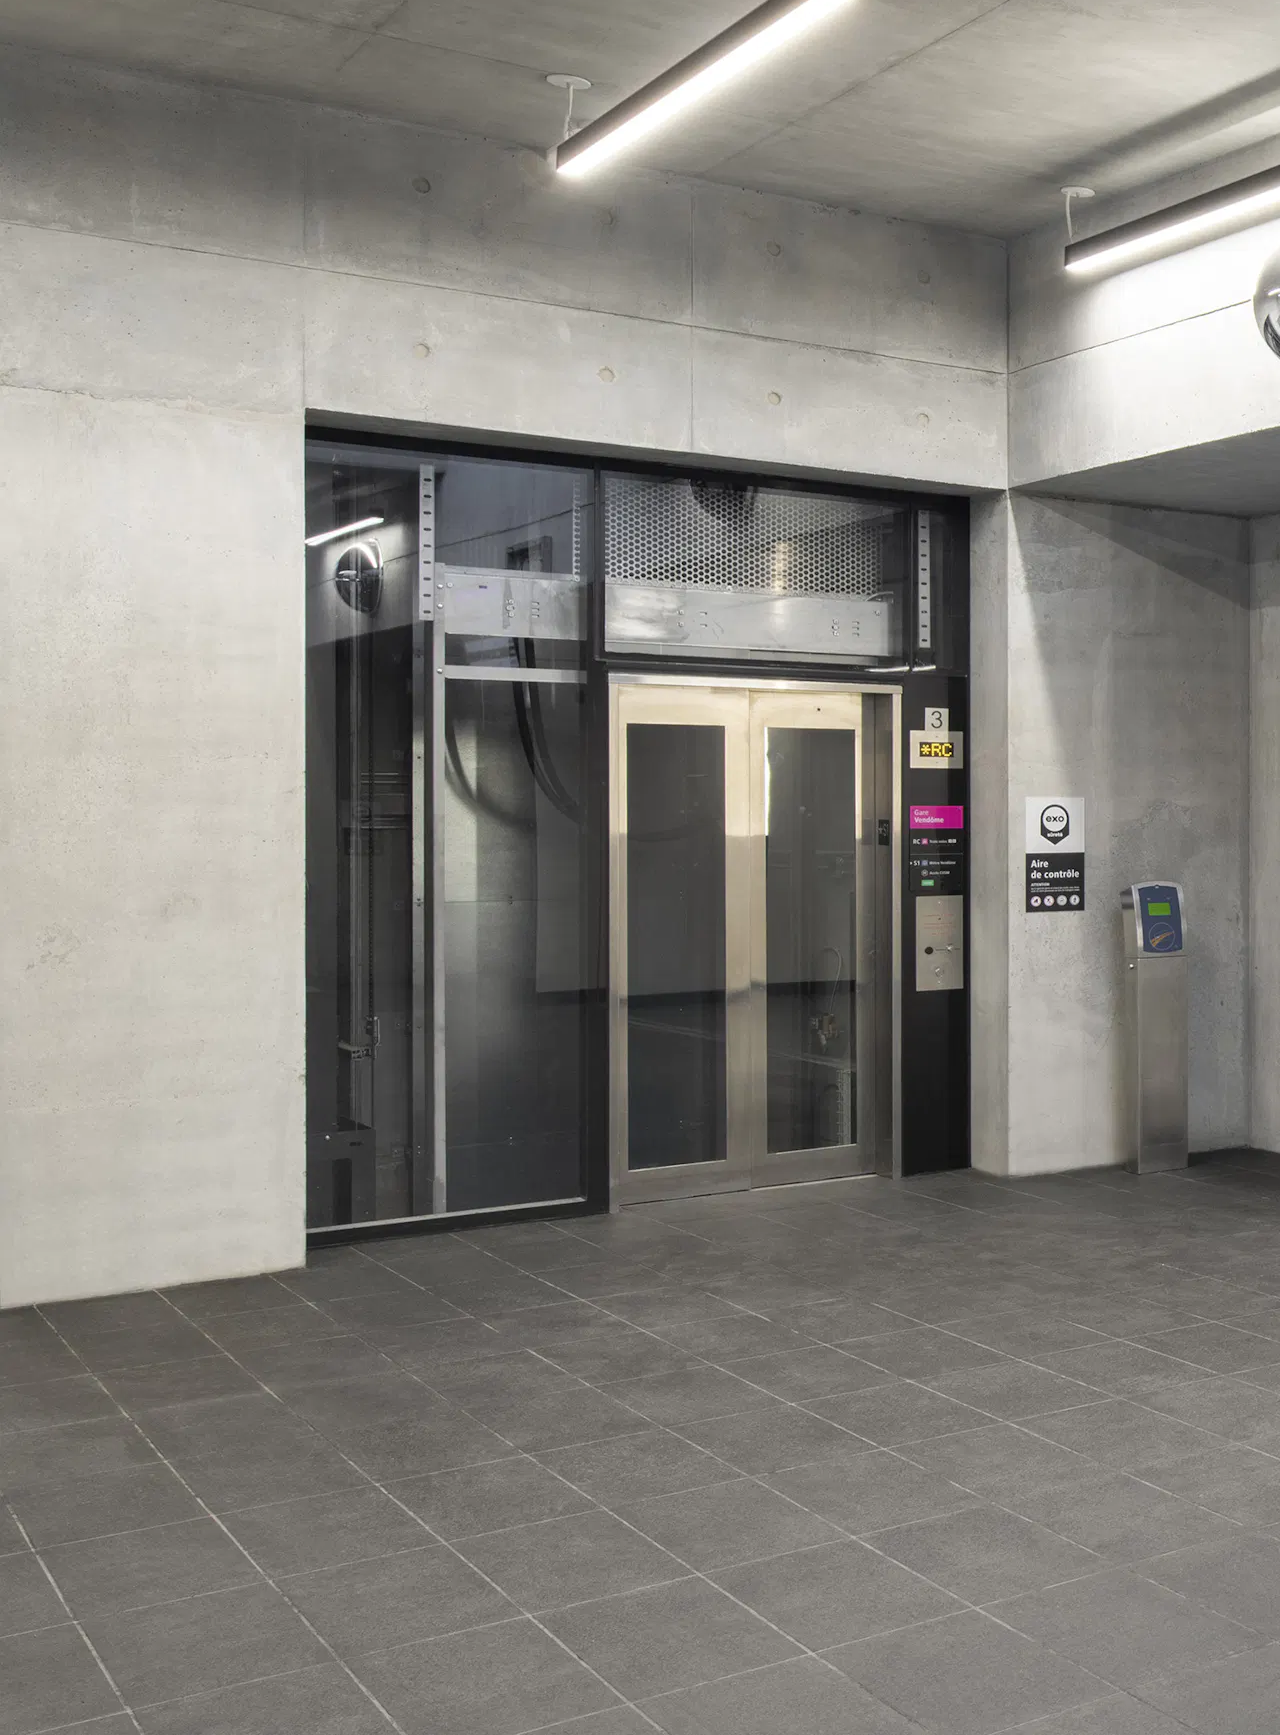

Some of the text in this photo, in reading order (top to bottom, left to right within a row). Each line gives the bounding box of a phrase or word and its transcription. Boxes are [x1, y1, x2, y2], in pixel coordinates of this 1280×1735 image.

[931, 710, 943, 729] 3
[1045, 815, 1065, 823] exo
[1030, 859, 1049, 869] Aire
[1030, 869, 1080, 879] de contrôle
